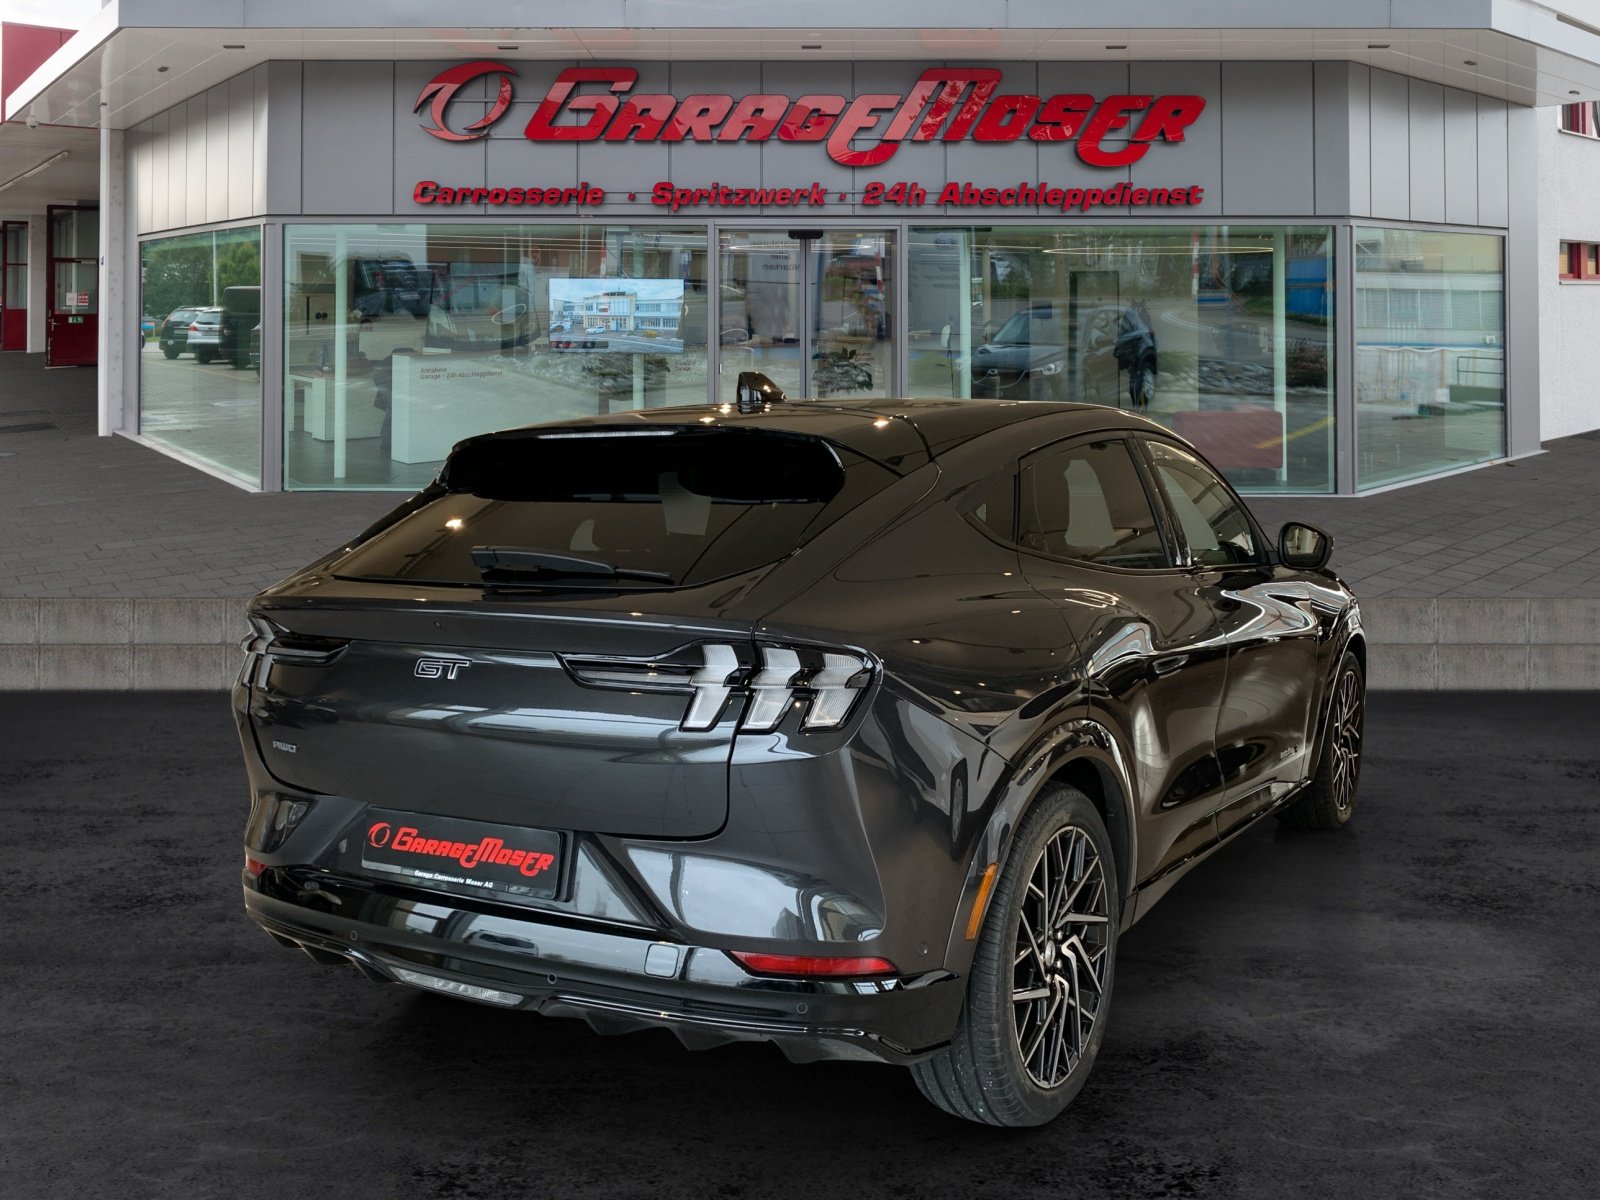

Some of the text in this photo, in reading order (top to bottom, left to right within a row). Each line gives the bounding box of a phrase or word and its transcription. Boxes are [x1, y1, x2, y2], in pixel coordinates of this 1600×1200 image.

[413, 180, 1204, 212] Carrosserie Spritzwerk 24h Abschleppdienst
[414, 658, 471, 680] GT
[415, 869, 433, 878] Garage
[434, 873, 464, 883] Carrosserie
[466, 878, 483, 886] Moser
